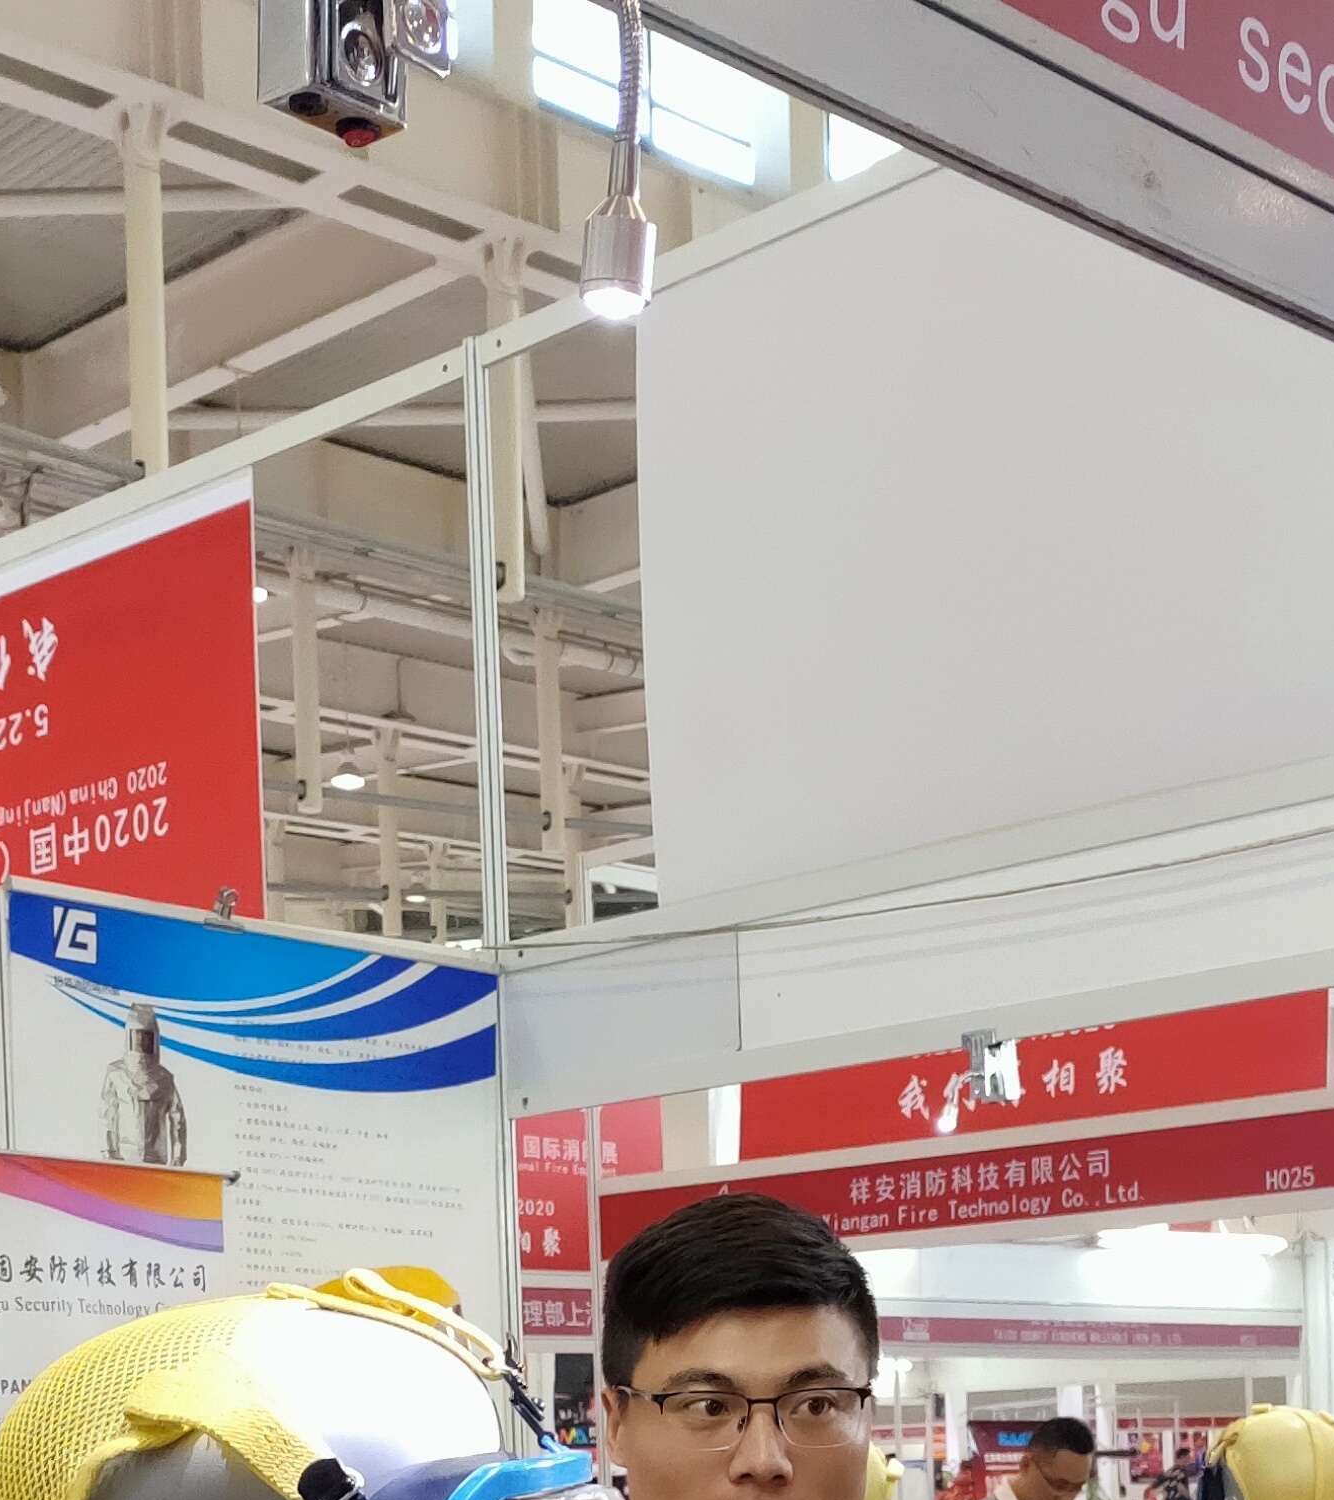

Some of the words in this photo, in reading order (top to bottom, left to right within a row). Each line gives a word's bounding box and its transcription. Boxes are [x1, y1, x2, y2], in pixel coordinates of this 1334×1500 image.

[128, 761, 168, 794] 2020
[898, 1045, 1127, 1121] 我们相聚
[523, 1134, 619, 1166] 国际消展
[849, 1149, 1111, 1206] 祥安消防科技有限公司
[1267, 1165, 1315, 1190] H025
[897, 1204, 938, 1227] Fire
[948, 1193, 1052, 1222] Technology
[15, 1296, 75, 1316] Security
[78, 1298, 151, 1320] Technology
